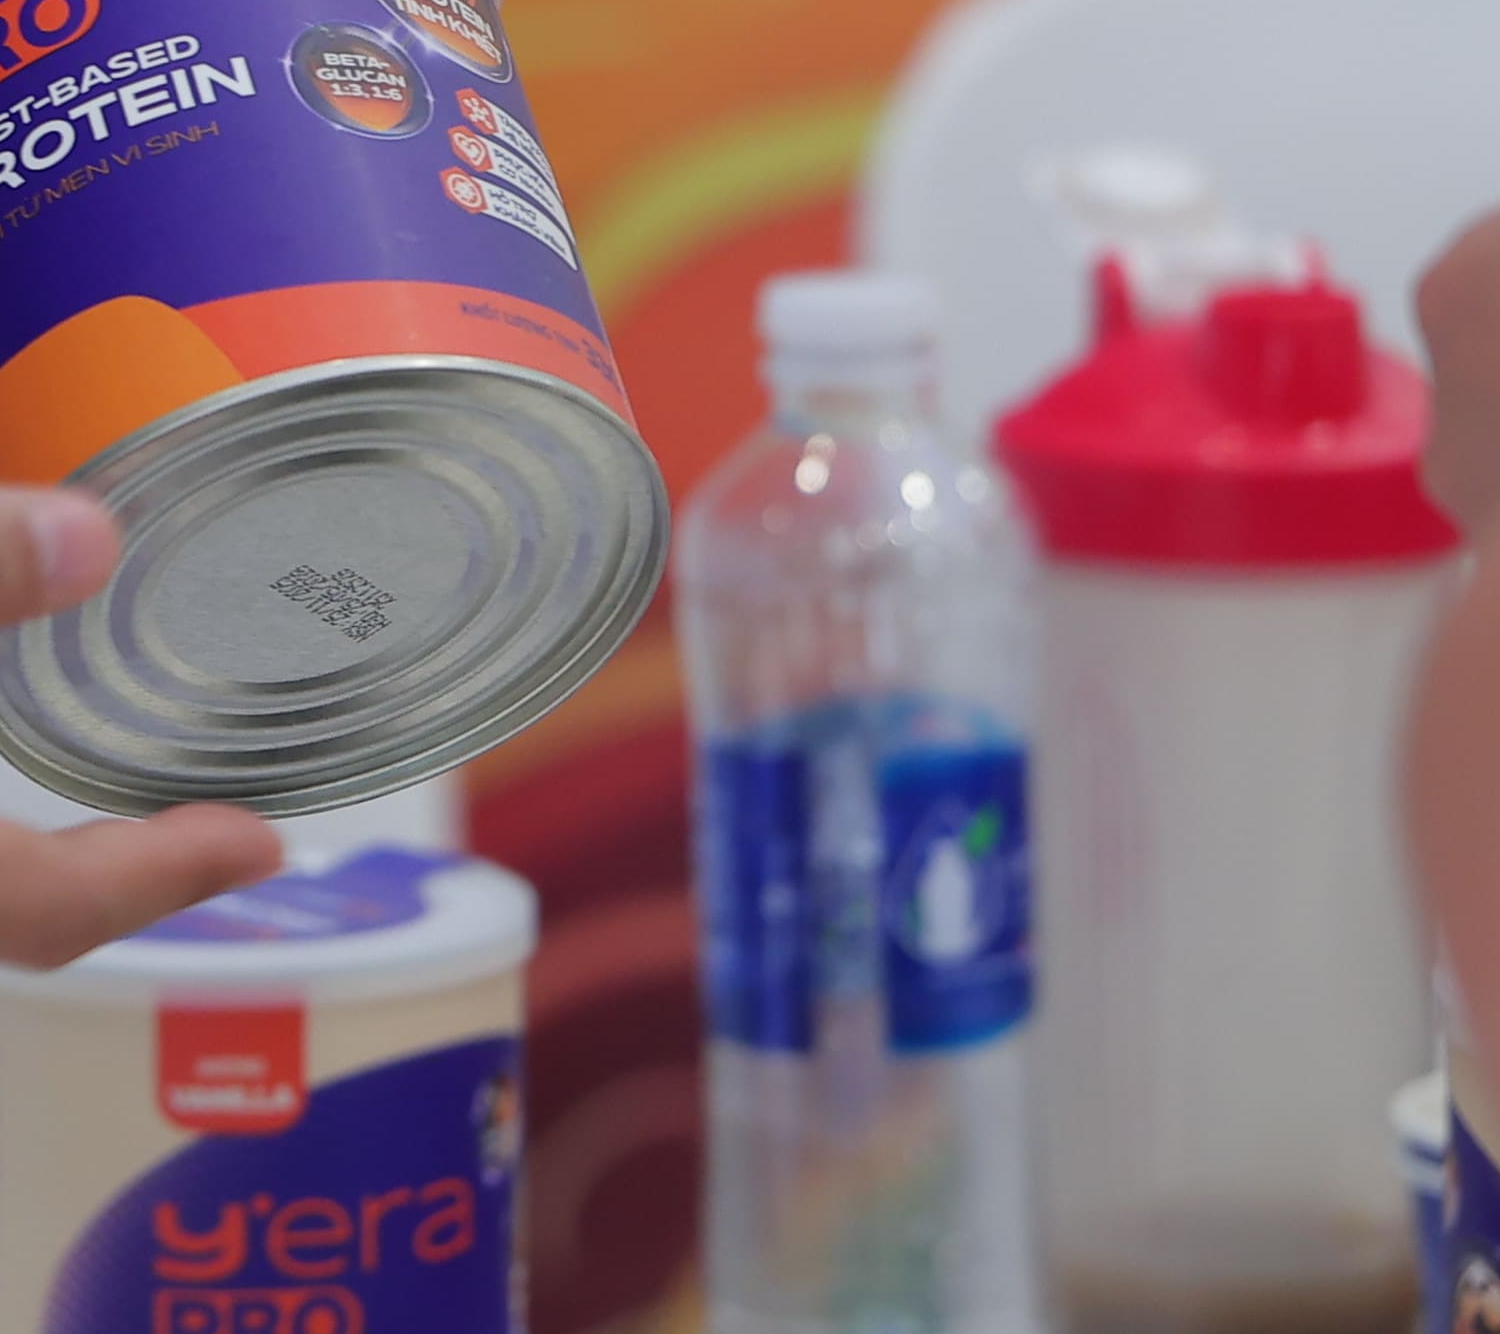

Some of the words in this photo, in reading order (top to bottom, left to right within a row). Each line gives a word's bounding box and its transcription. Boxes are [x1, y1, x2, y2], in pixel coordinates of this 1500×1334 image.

[323, 53, 391, 69] BETA-
[316, 67, 406, 87] GLUCAN
[45, 160, 112, 203] MEN
[111, 145, 143, 167] VI
[146, 120, 221, 155] SINH
